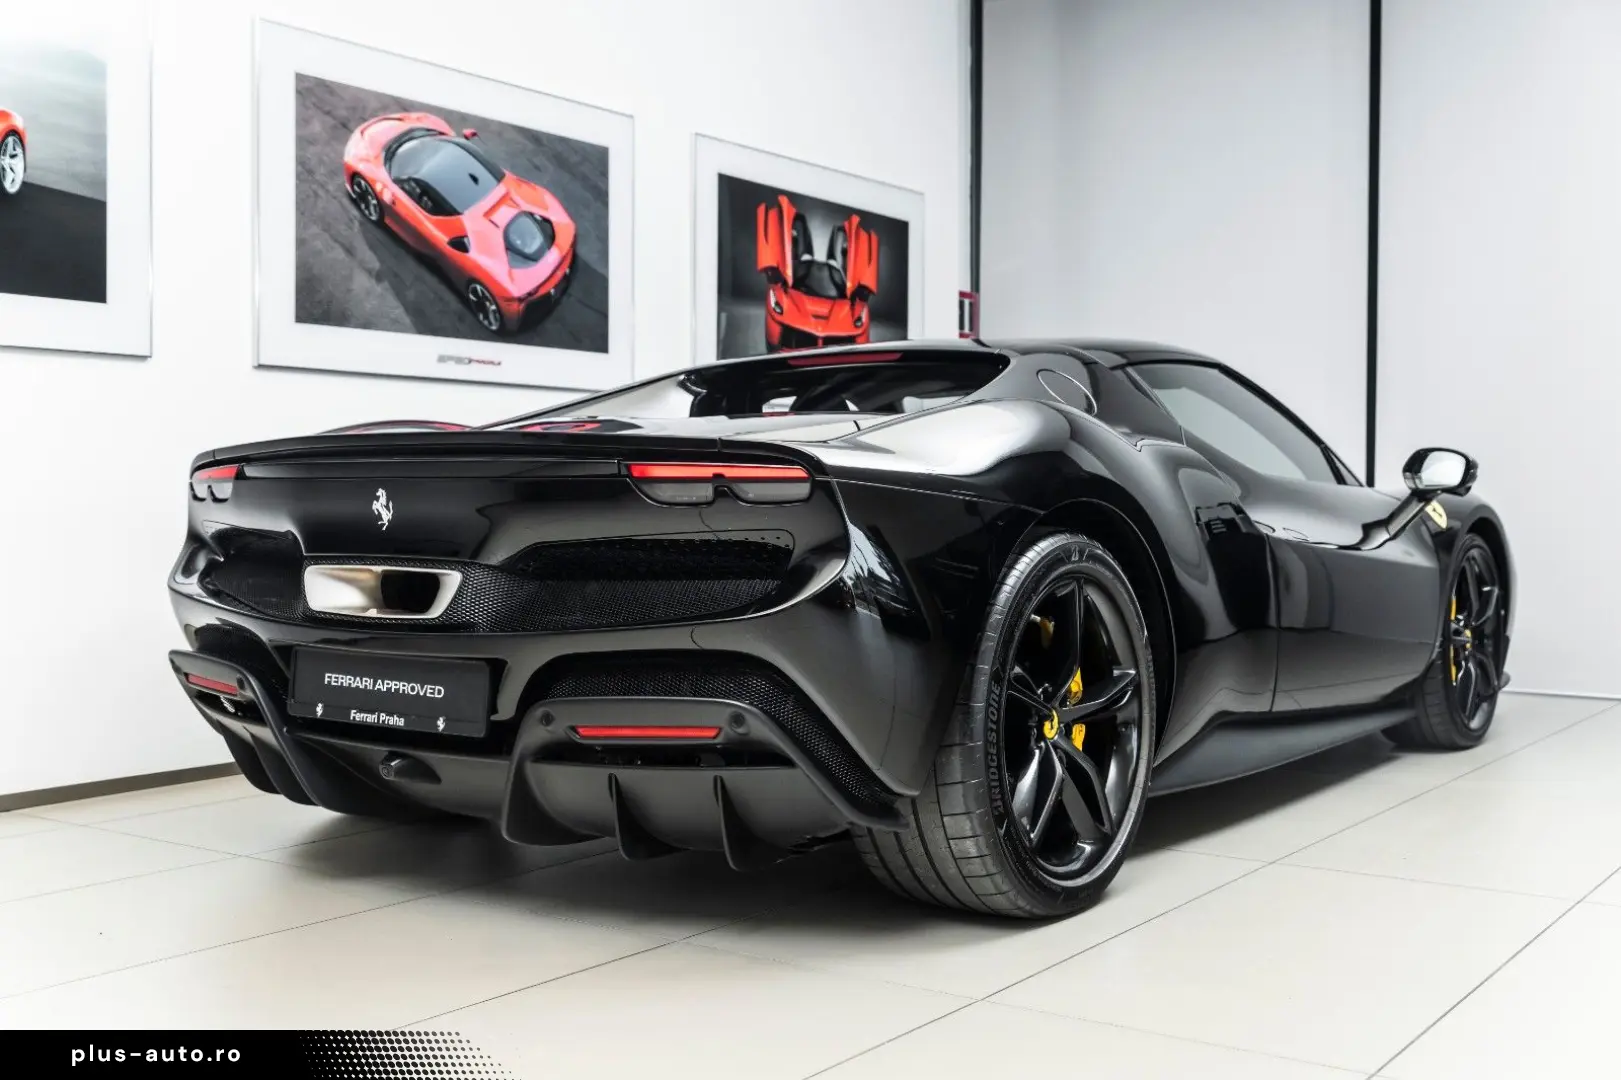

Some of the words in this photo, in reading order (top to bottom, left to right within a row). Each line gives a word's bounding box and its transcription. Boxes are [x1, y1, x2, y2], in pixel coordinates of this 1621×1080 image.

[324, 673, 373, 690] FERRARI
[375, 680, 444, 698] APPROVED
[350, 709, 378, 723] Ferrari
[379, 712, 405, 726] Praha
[986, 681, 1004, 816] BRIDGESTONE
